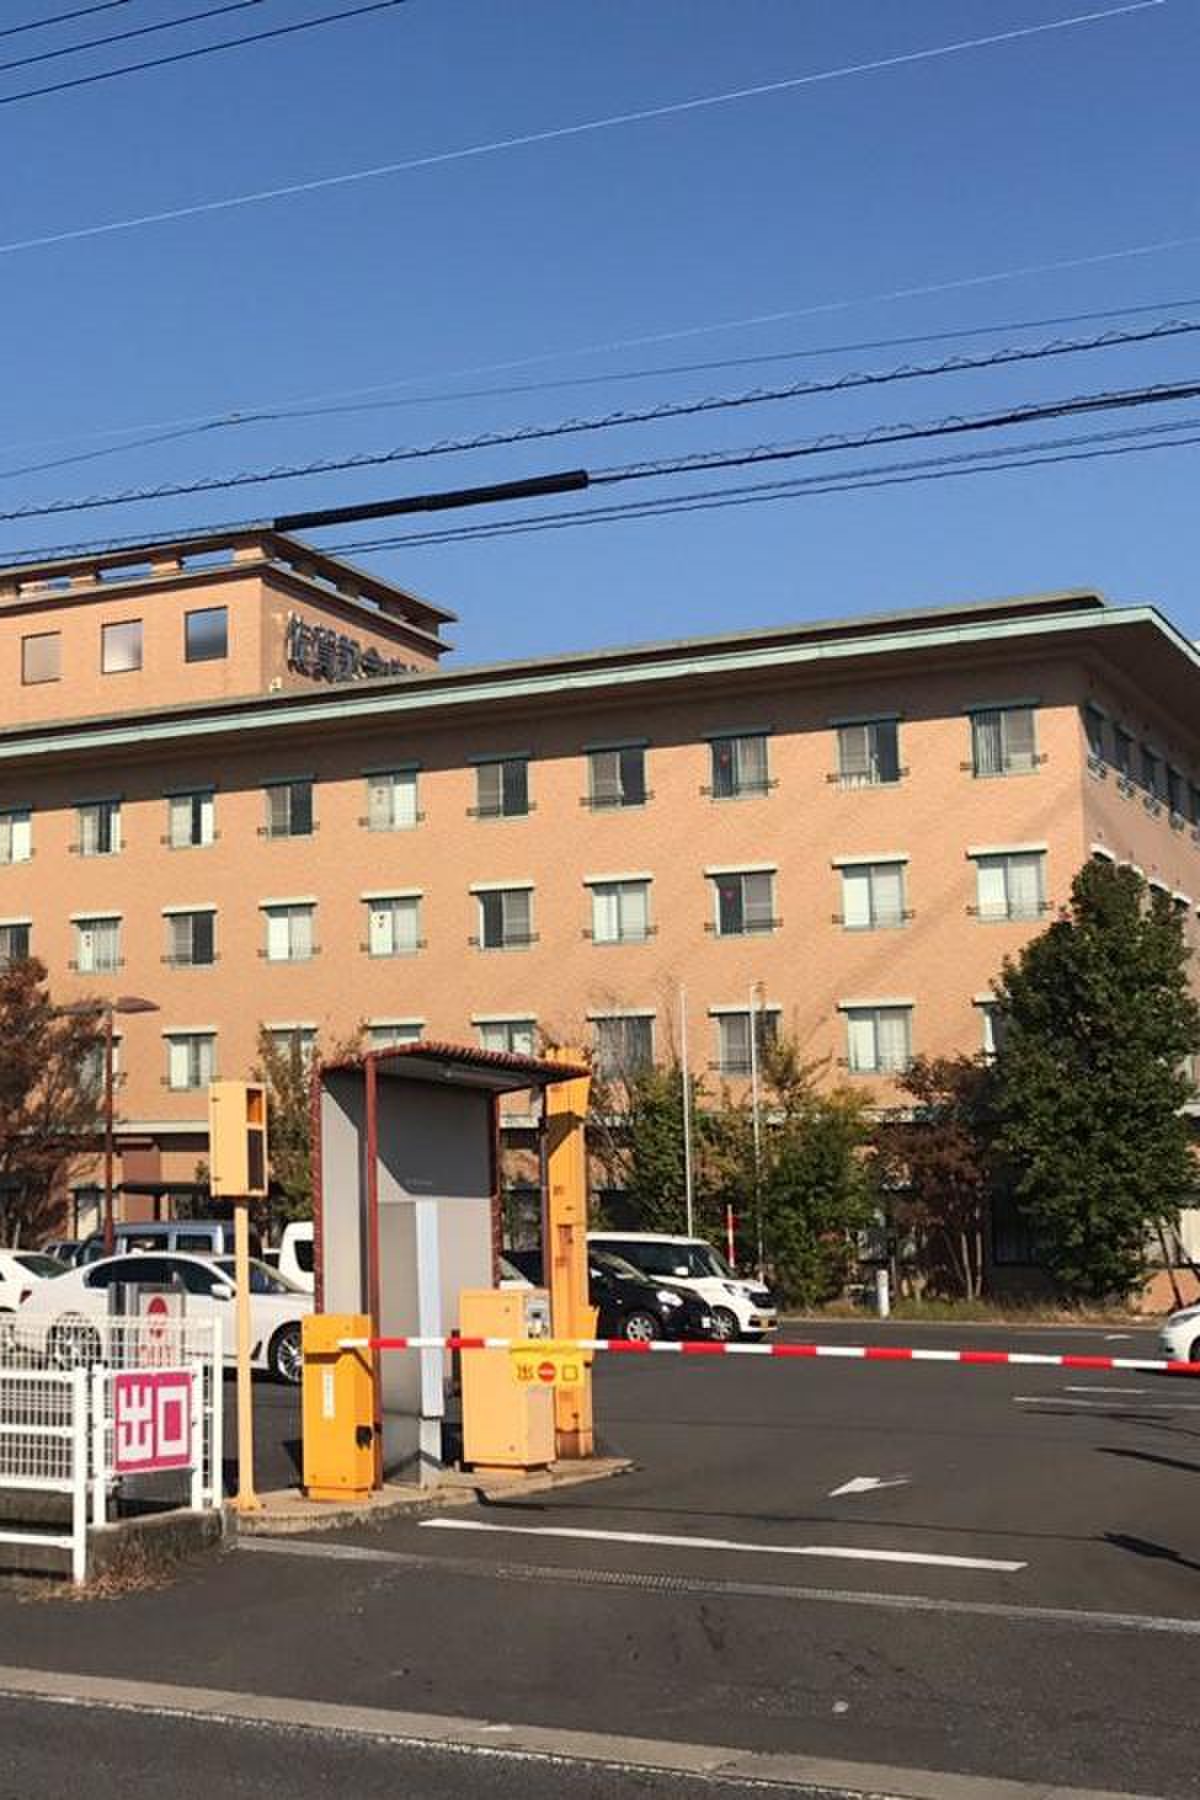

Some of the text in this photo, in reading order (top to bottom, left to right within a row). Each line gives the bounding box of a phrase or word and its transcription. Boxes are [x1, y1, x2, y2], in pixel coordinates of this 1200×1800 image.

[286, 611, 424, 685] 佐賀記念
[118, 1384, 189, 1463] 出口
